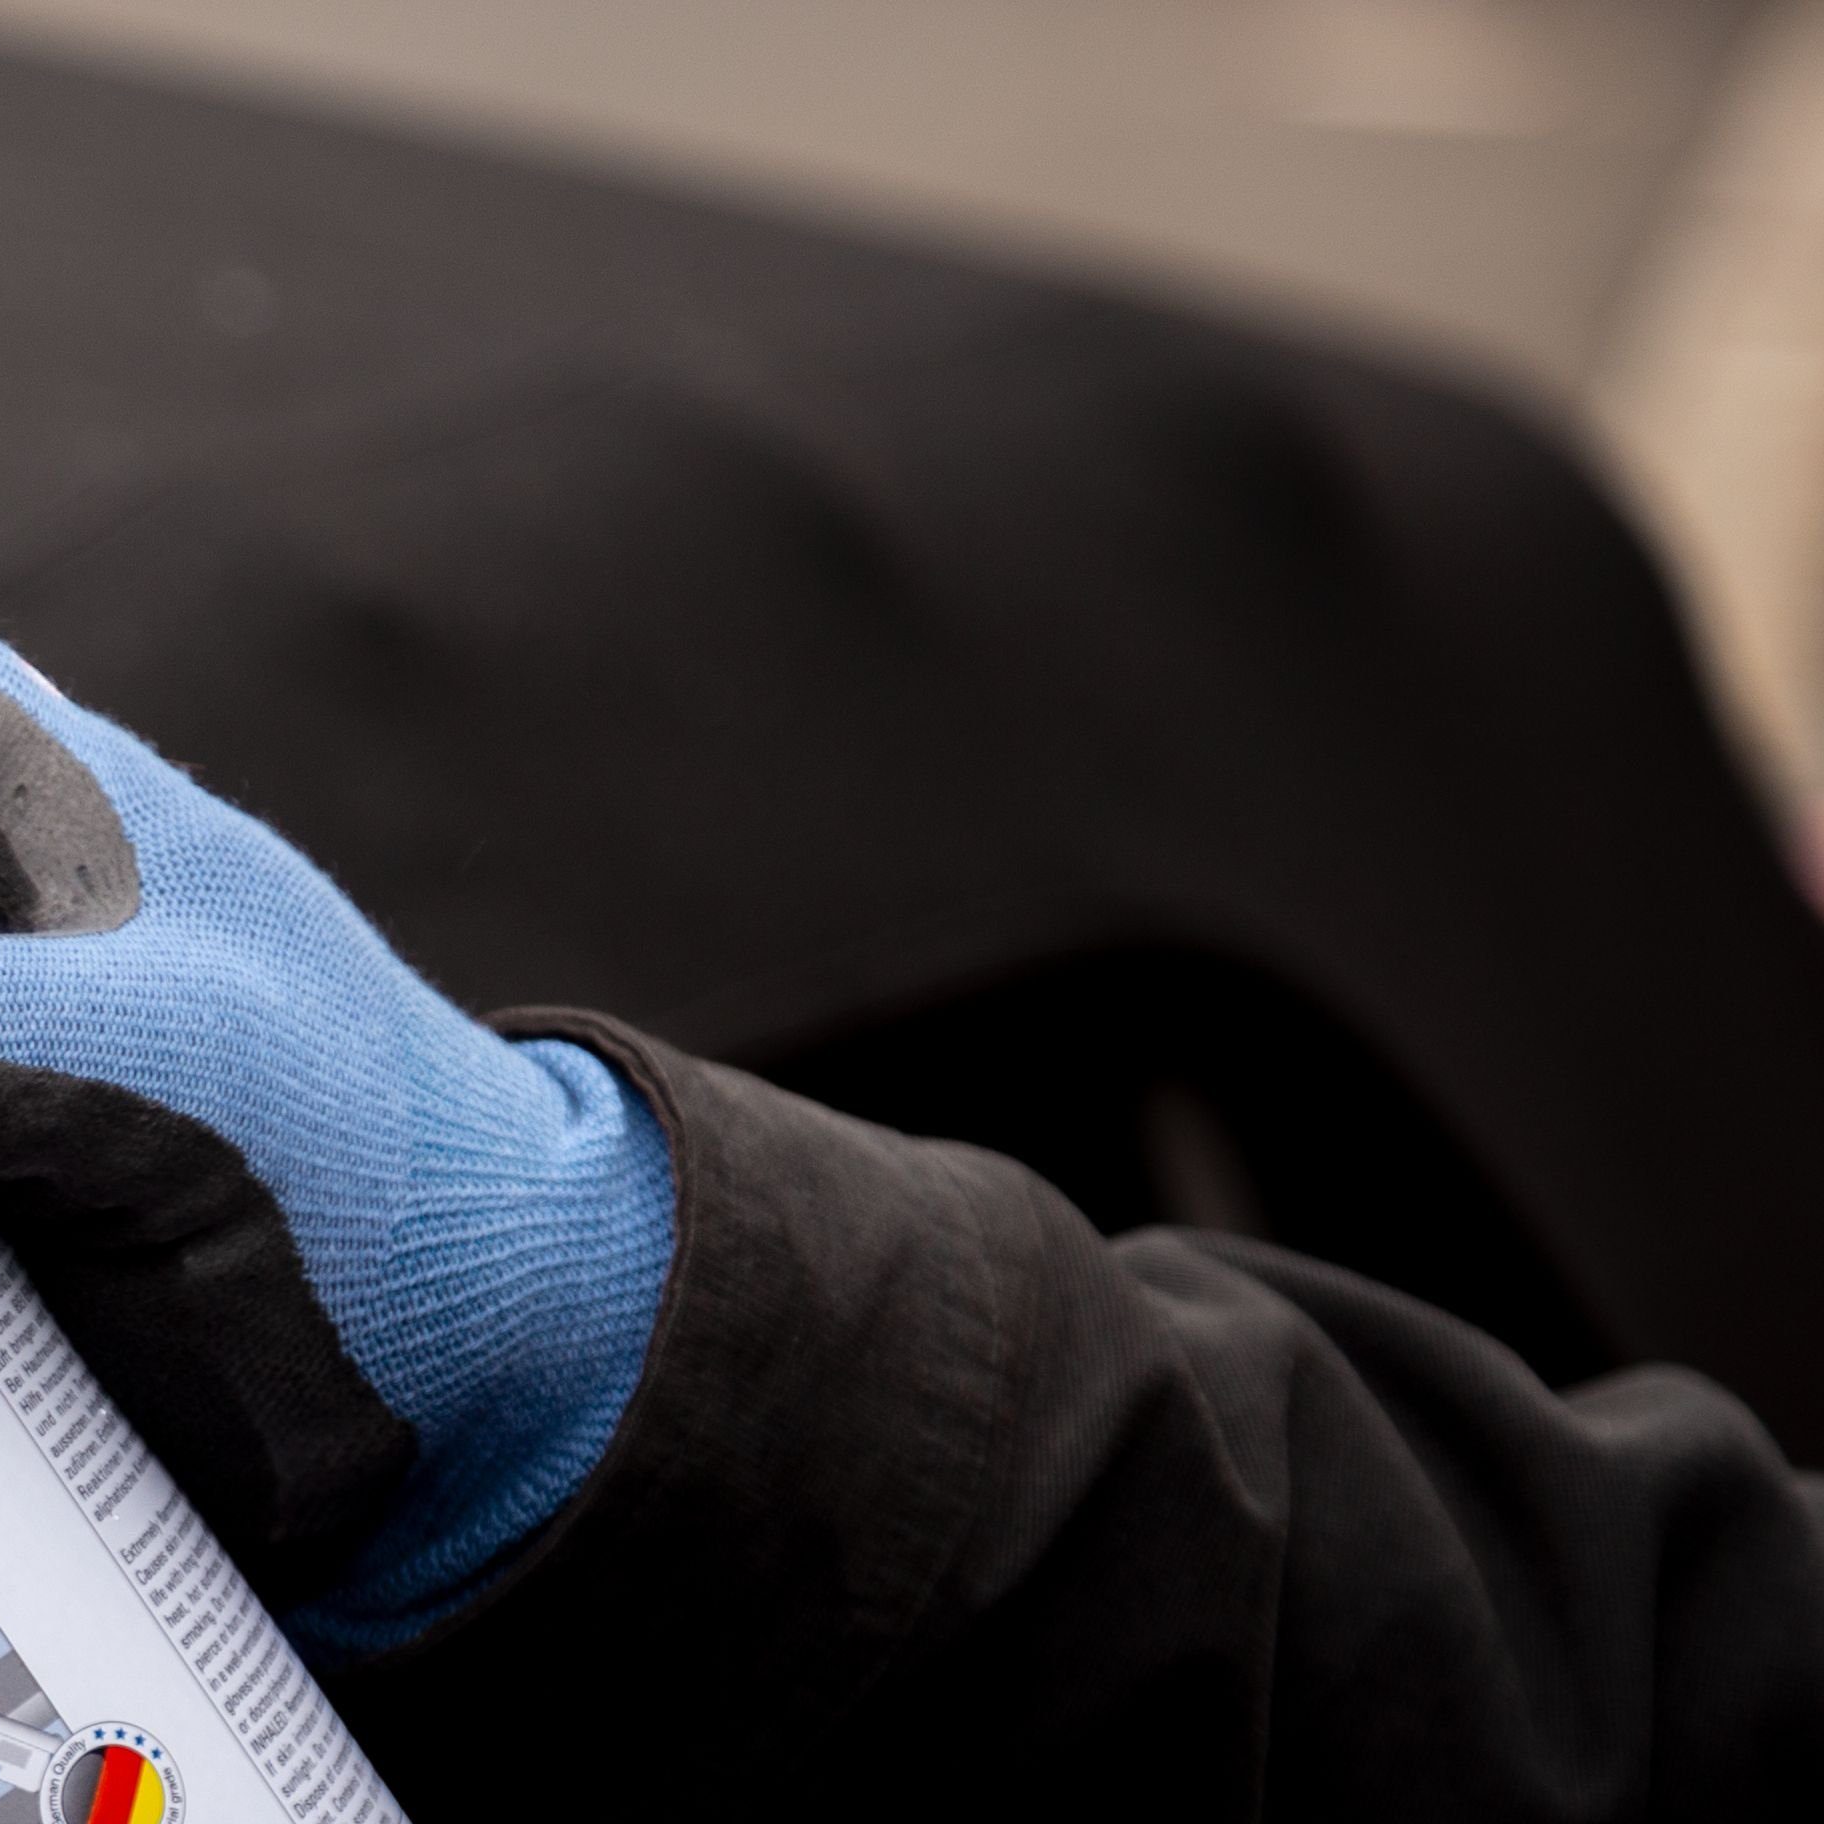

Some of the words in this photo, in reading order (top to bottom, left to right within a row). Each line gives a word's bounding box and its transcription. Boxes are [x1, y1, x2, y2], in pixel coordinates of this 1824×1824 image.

[5, 1371, 25, 1394] Bei
[34, 1412, 57, 1437] und
[53, 1739, 87, 1775] Quality
[164, 1766, 184, 1804] grade
